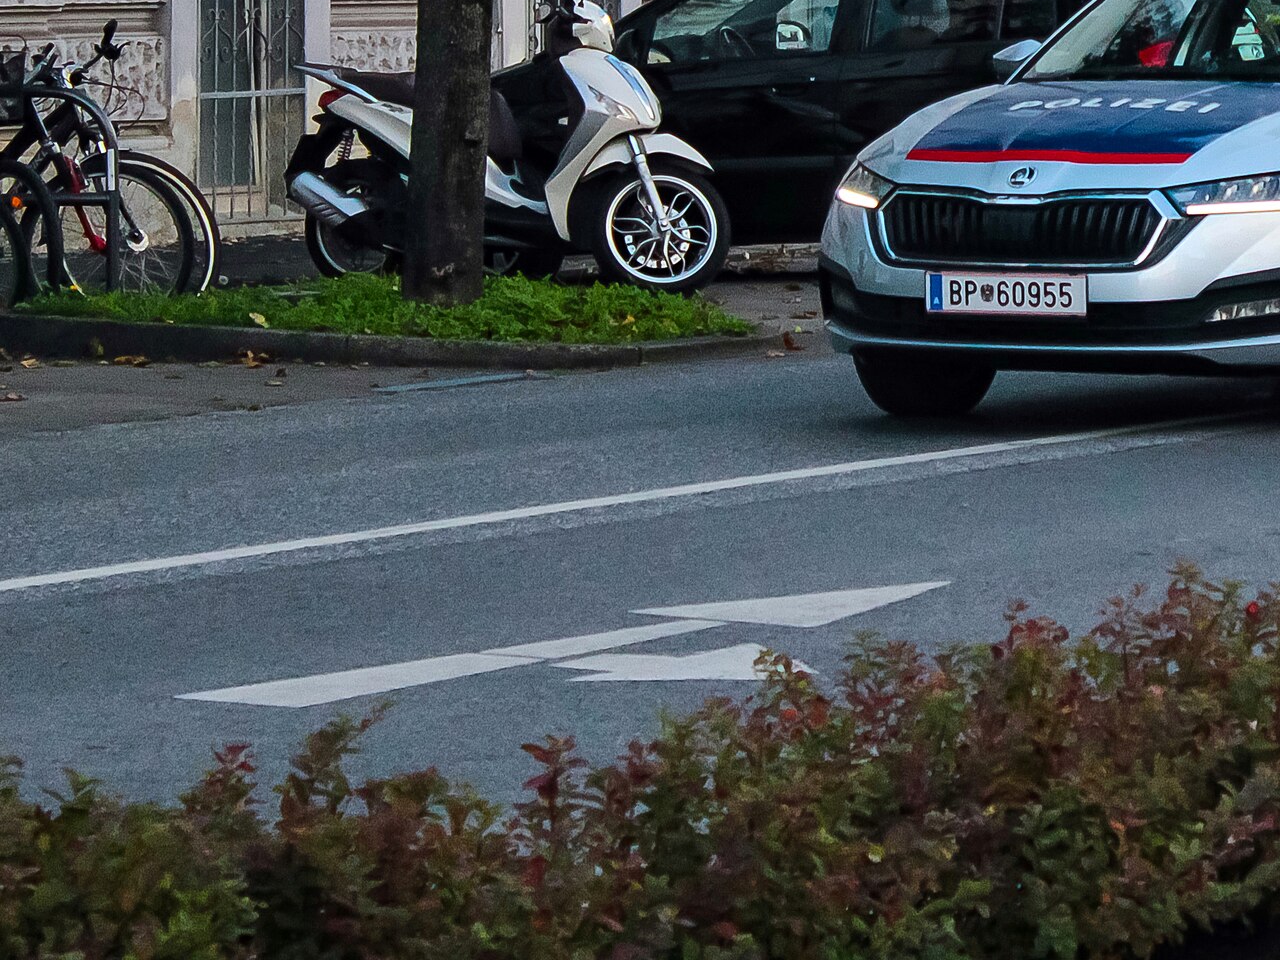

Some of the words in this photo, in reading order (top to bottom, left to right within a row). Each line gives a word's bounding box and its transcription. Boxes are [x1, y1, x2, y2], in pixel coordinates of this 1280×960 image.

[1009, 97, 1221, 114] POLIZEI
[950, 280, 977, 306] BP
[997, 281, 1072, 308] 60955
